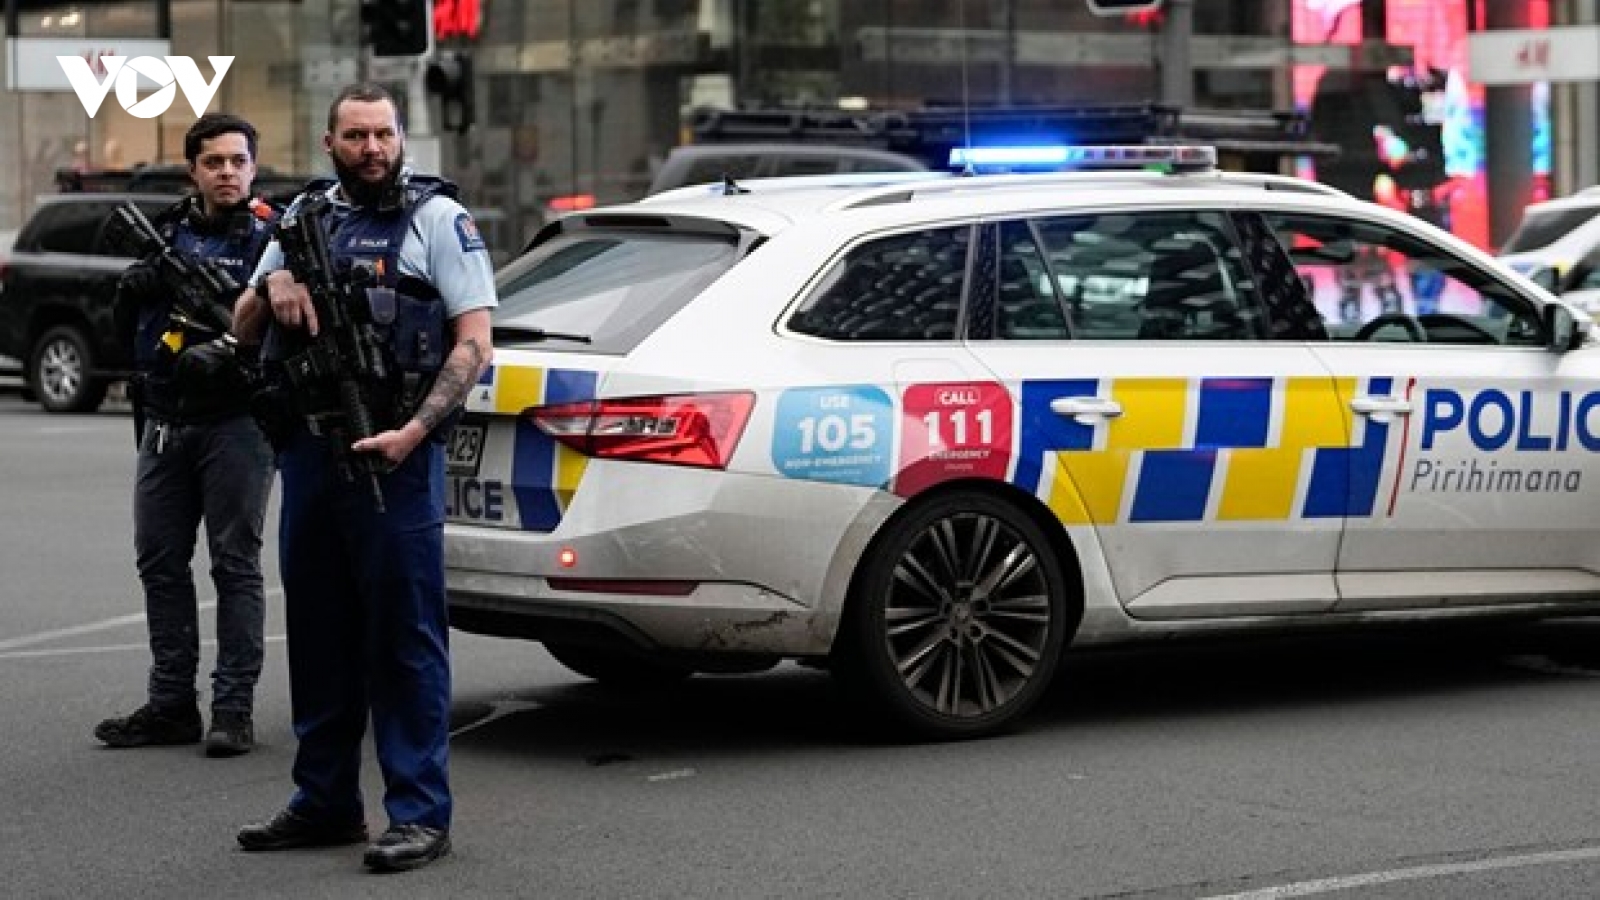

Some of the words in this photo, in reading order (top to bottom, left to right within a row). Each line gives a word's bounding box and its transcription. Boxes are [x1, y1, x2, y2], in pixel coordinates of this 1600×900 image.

[819, 395, 850, 409] USE
[938, 390, 977, 405] CALL
[797, 414, 876, 454] 105
[923, 409, 992, 446] 111
[1410, 458, 1582, 493] Pirihimana
